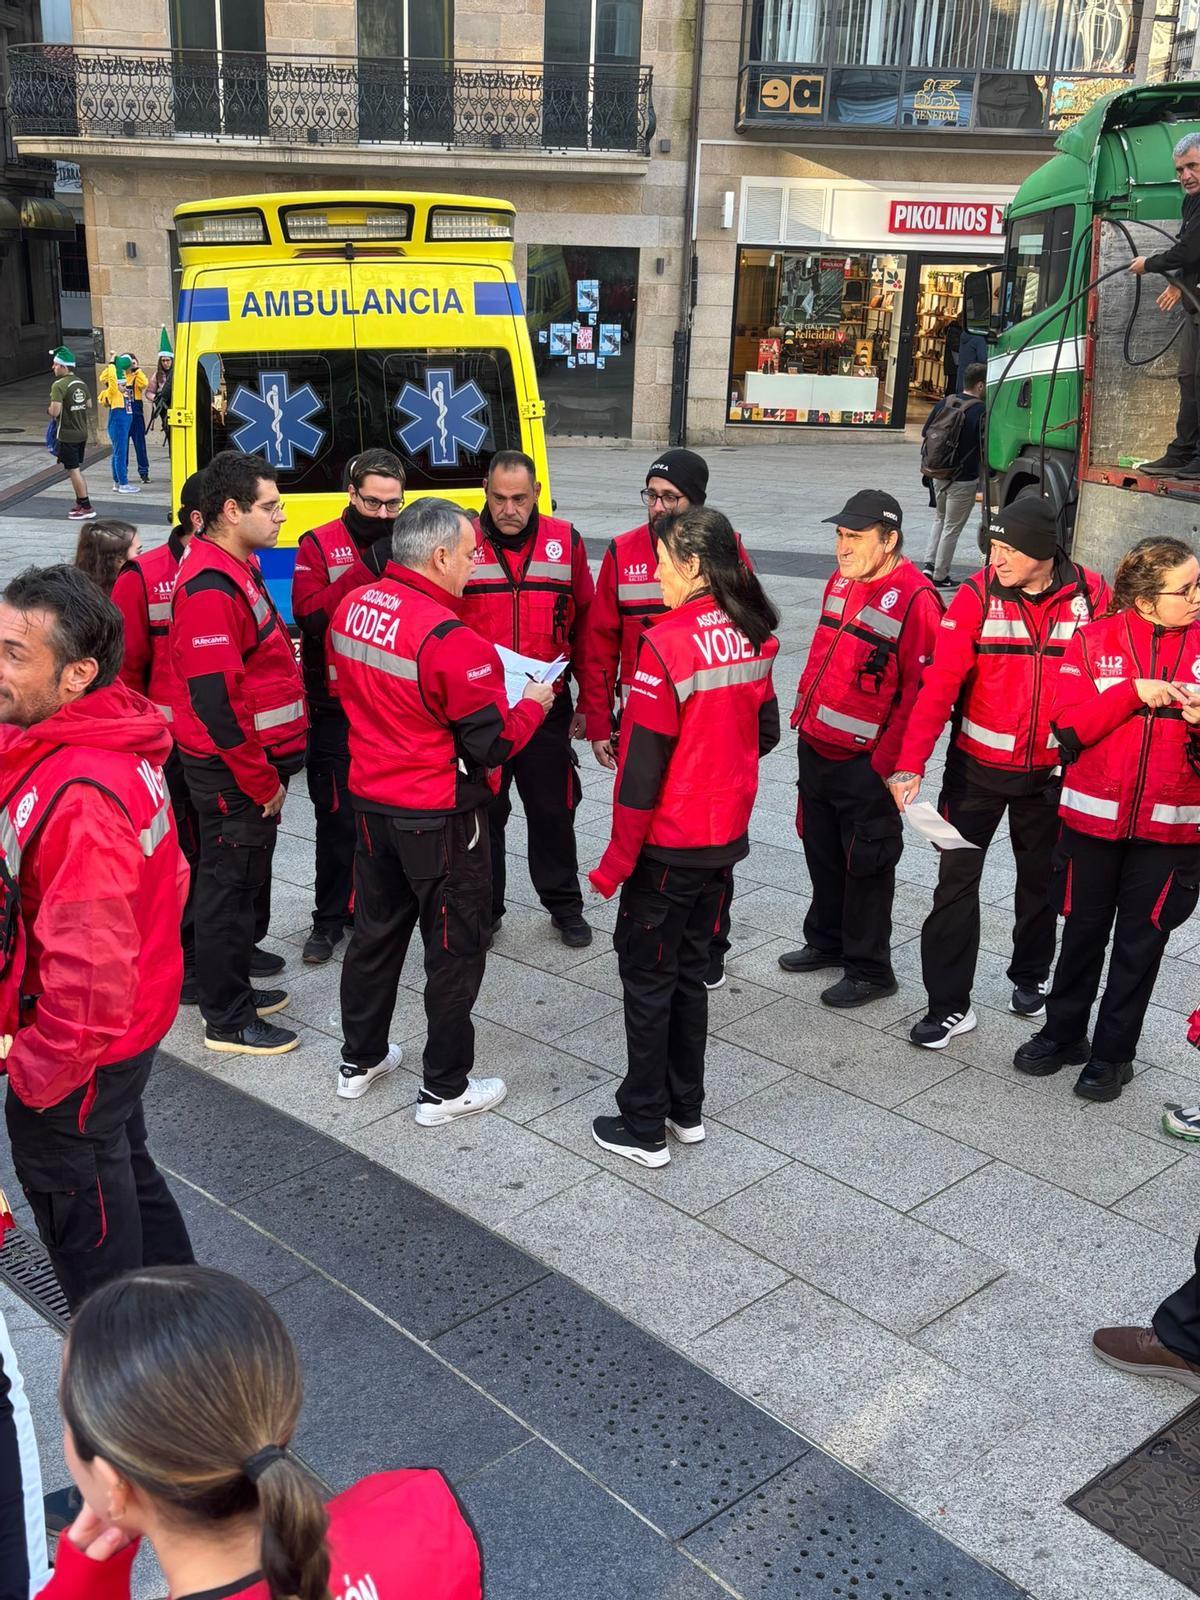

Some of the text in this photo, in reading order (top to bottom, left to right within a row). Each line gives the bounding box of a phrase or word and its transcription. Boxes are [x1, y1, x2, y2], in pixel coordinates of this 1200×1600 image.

[914, 110, 959, 121] GENERALI
[894, 205, 987, 232] PIKOLINOS
[241, 288, 464, 318] AMBULANCIA
[335, 546, 353, 557] 112
[629, 564, 648, 575] 112
[345, 602, 401, 650] VODEA
[1100, 656, 1123, 668] 112
